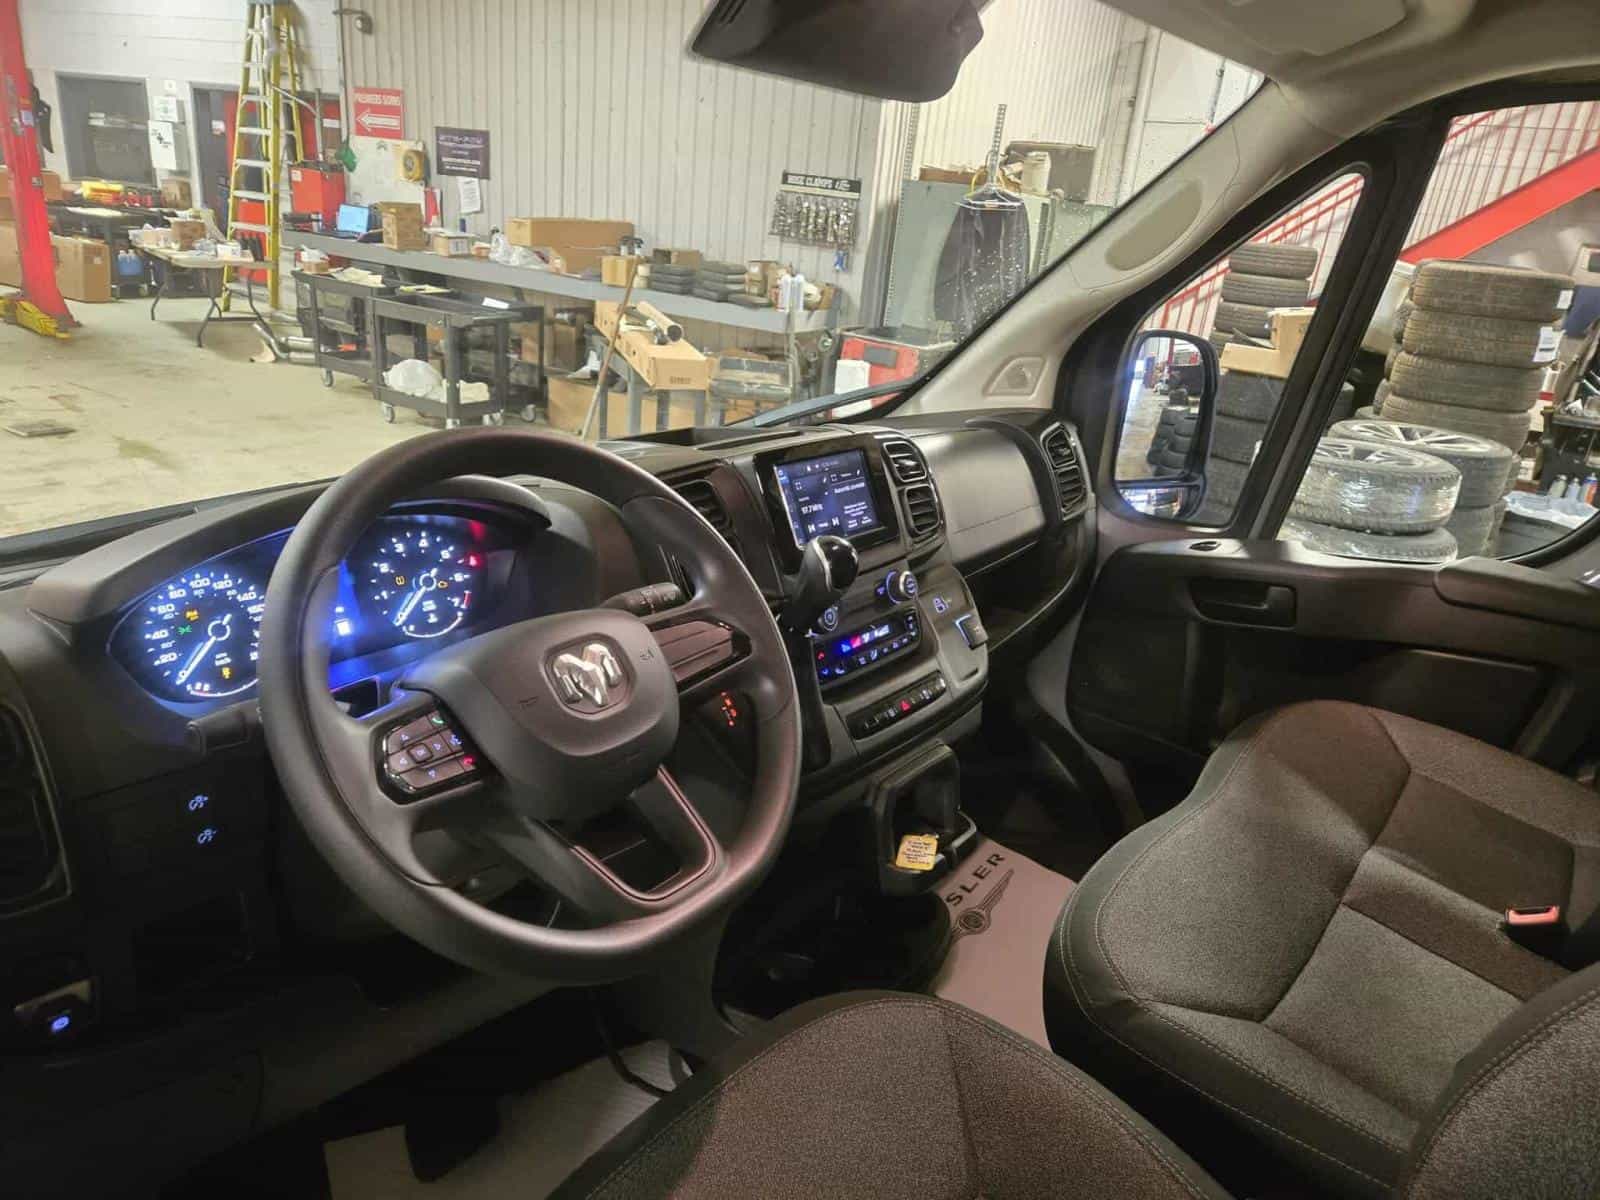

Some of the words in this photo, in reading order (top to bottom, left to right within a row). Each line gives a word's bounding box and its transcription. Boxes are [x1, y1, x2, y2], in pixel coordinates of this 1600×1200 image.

[418, 538, 429, 548] 4
[189, 577, 211, 589] 100
[212, 579, 233, 590] 120
[236, 591, 257, 602] 140
[152, 629, 169, 640] 40
[160, 652, 178, 664] 20
[945, 853, 1006, 907] SLER
